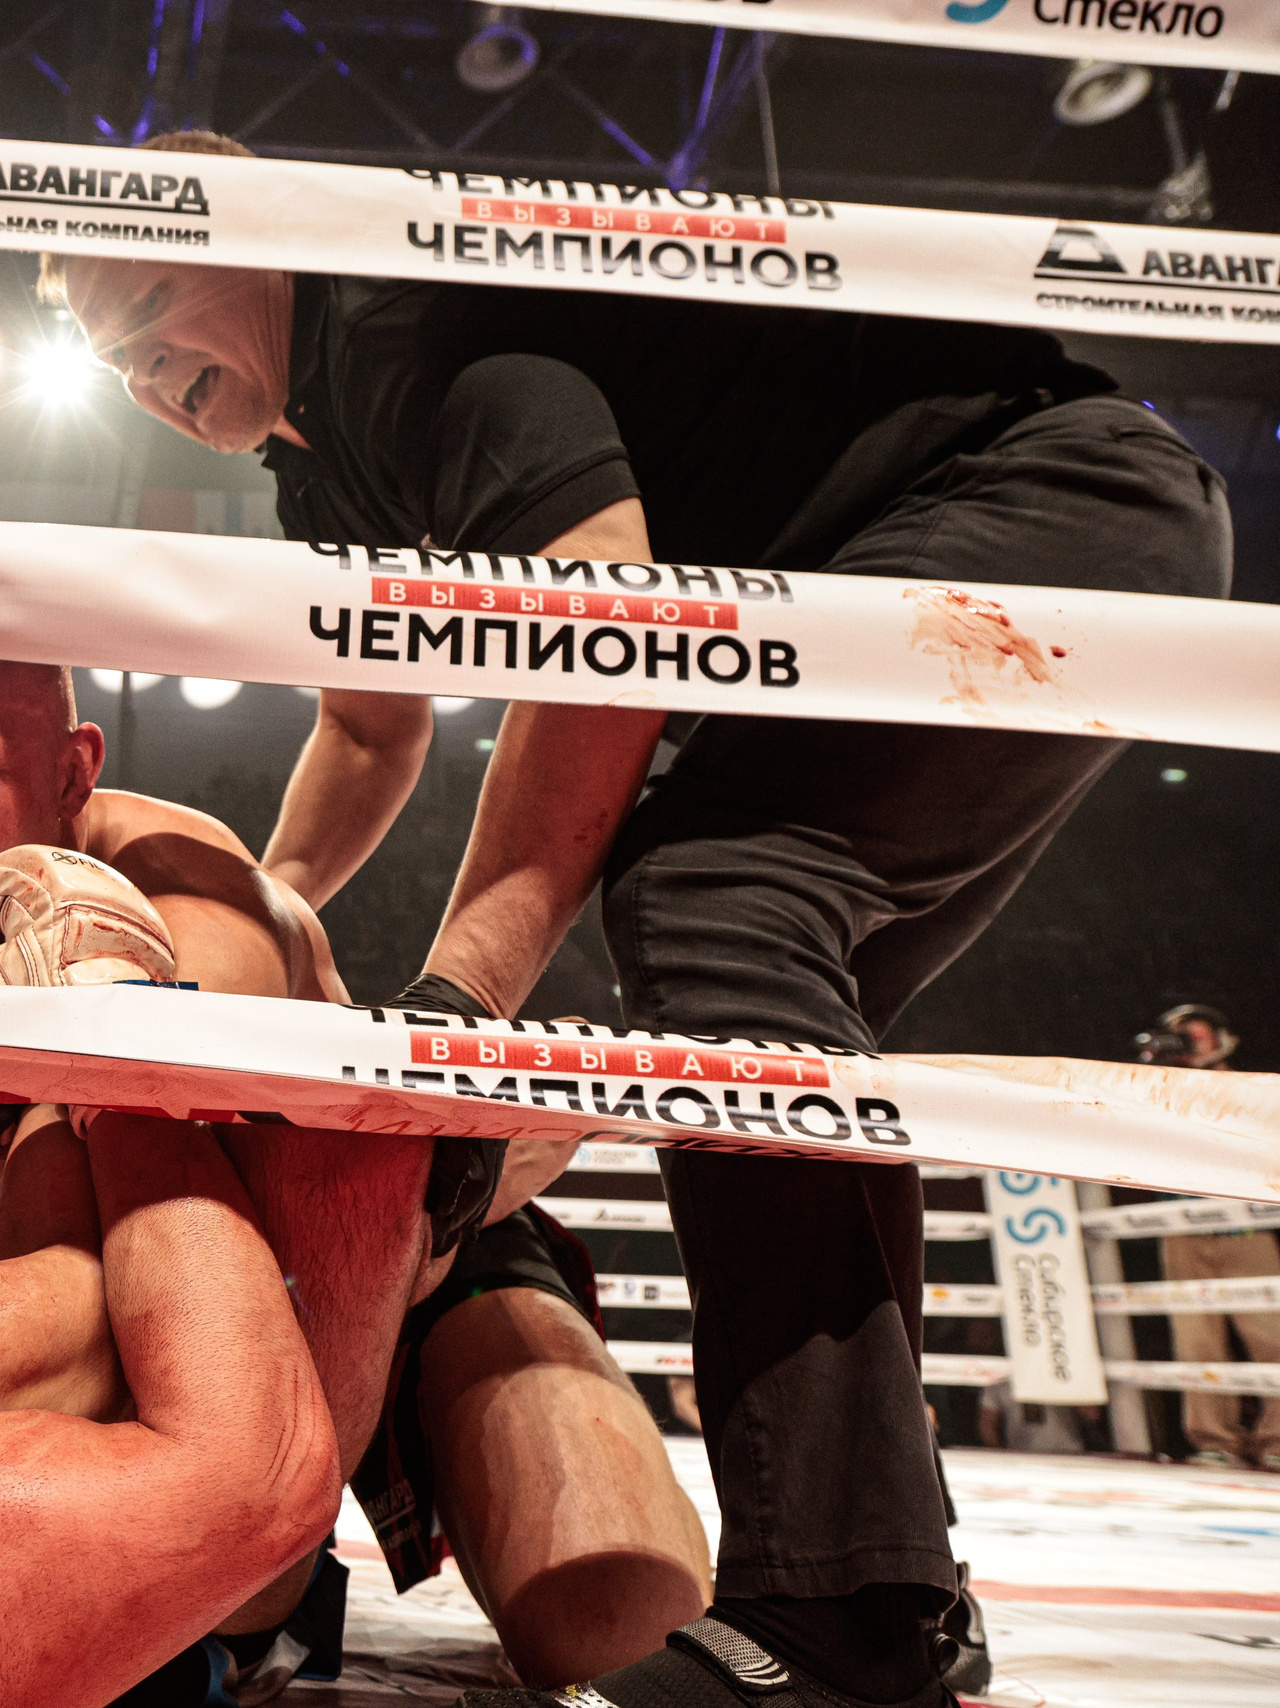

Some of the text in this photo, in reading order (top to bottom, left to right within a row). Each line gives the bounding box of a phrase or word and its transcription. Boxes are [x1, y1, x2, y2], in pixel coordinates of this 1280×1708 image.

[1033, 0, 1225, 38] Стекло
[65, 221, 211, 246] КОМПАНИЯ
[476, 200, 770, 241] ВЫЗЫВАЮТ
[406, 220, 844, 291] ЧЕМПИОНОВ
[1142, 250, 1280, 287] АВАНГ
[389, 581, 720, 626] ВЫЗЫВАЮТ
[309, 605, 801, 689] ЧЕМПИОНОВ
[430, 1036, 806, 1082] ВЫЗЫВАЮТ
